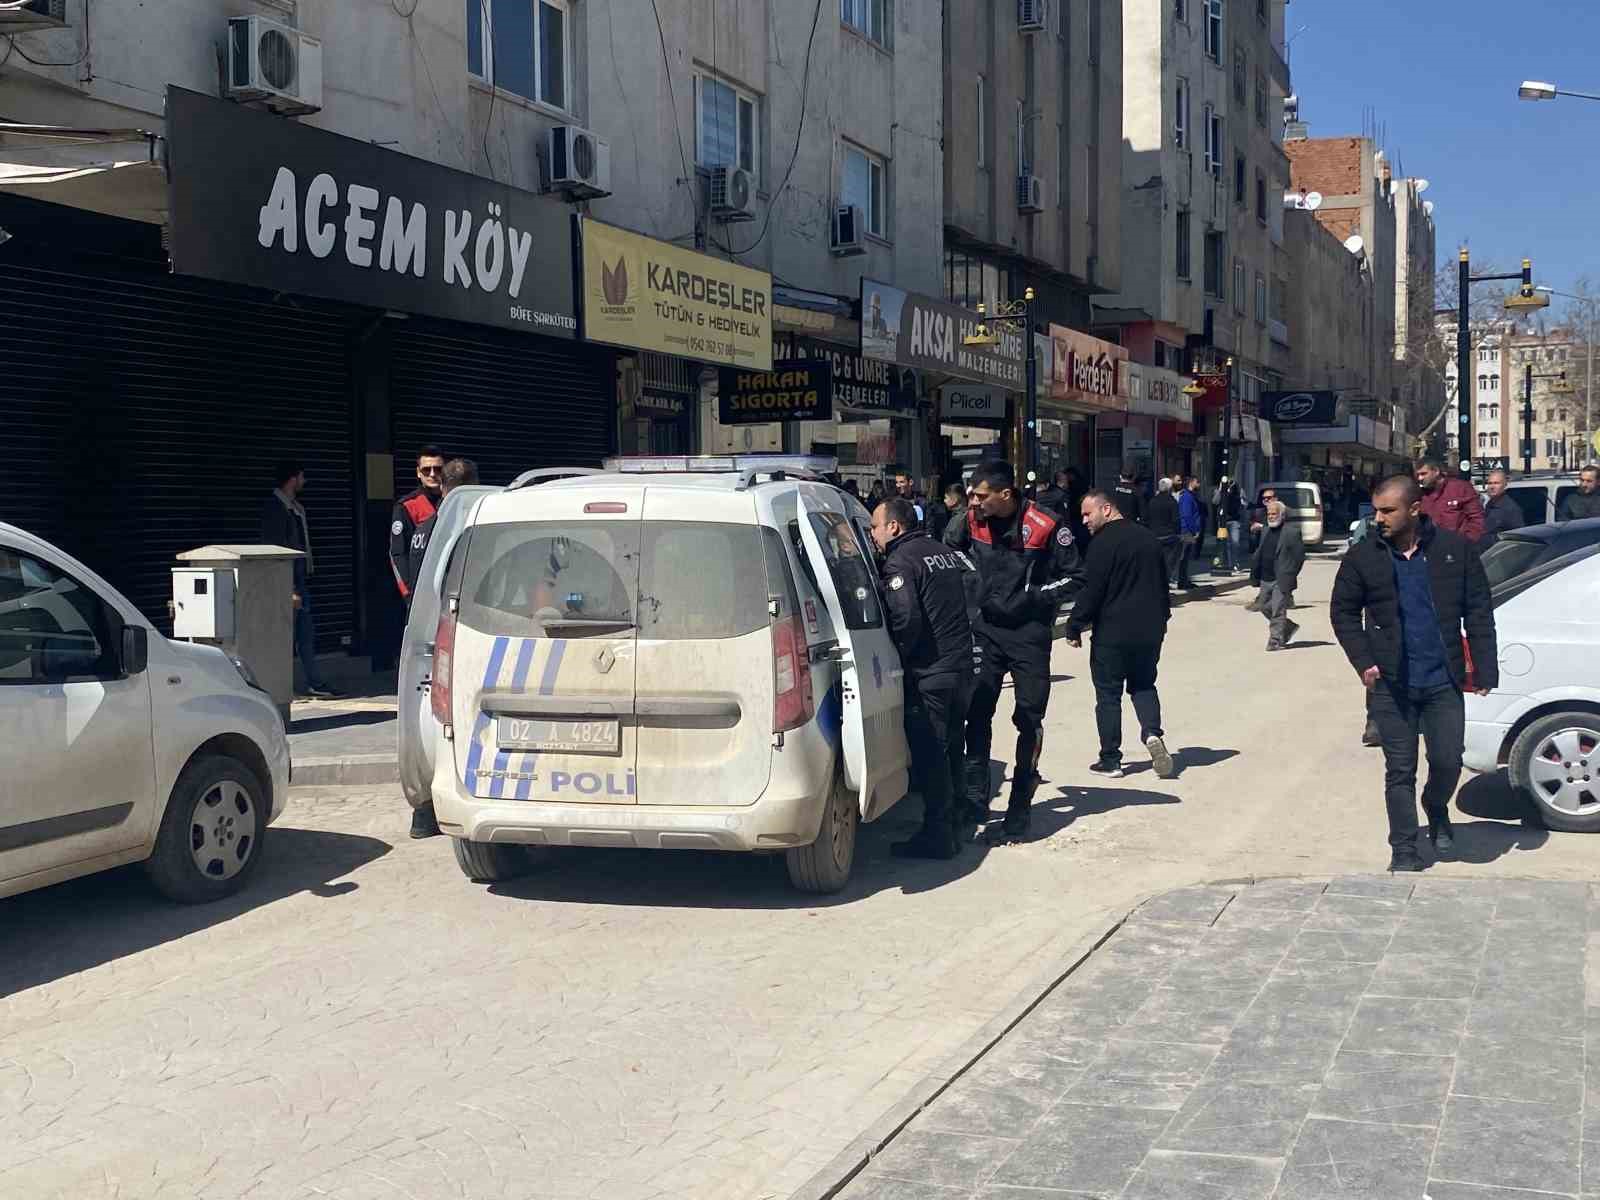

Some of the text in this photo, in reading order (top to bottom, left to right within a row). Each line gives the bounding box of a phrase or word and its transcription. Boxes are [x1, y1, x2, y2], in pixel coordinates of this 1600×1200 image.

[258, 166, 533, 299] ACEM KÖY
[647, 261, 766, 317] KARDEŞLER
[510, 305, 533, 322] BÜFE
[654, 300, 693, 323] TÜTÜN
[697, 312, 705, 326] &
[910, 306, 954, 363] AKSA
[737, 370, 809, 391] HAKAN
[855, 356, 890, 385] UMRE
[511, 720, 530, 742] 02
[549, 724, 561, 743] A
